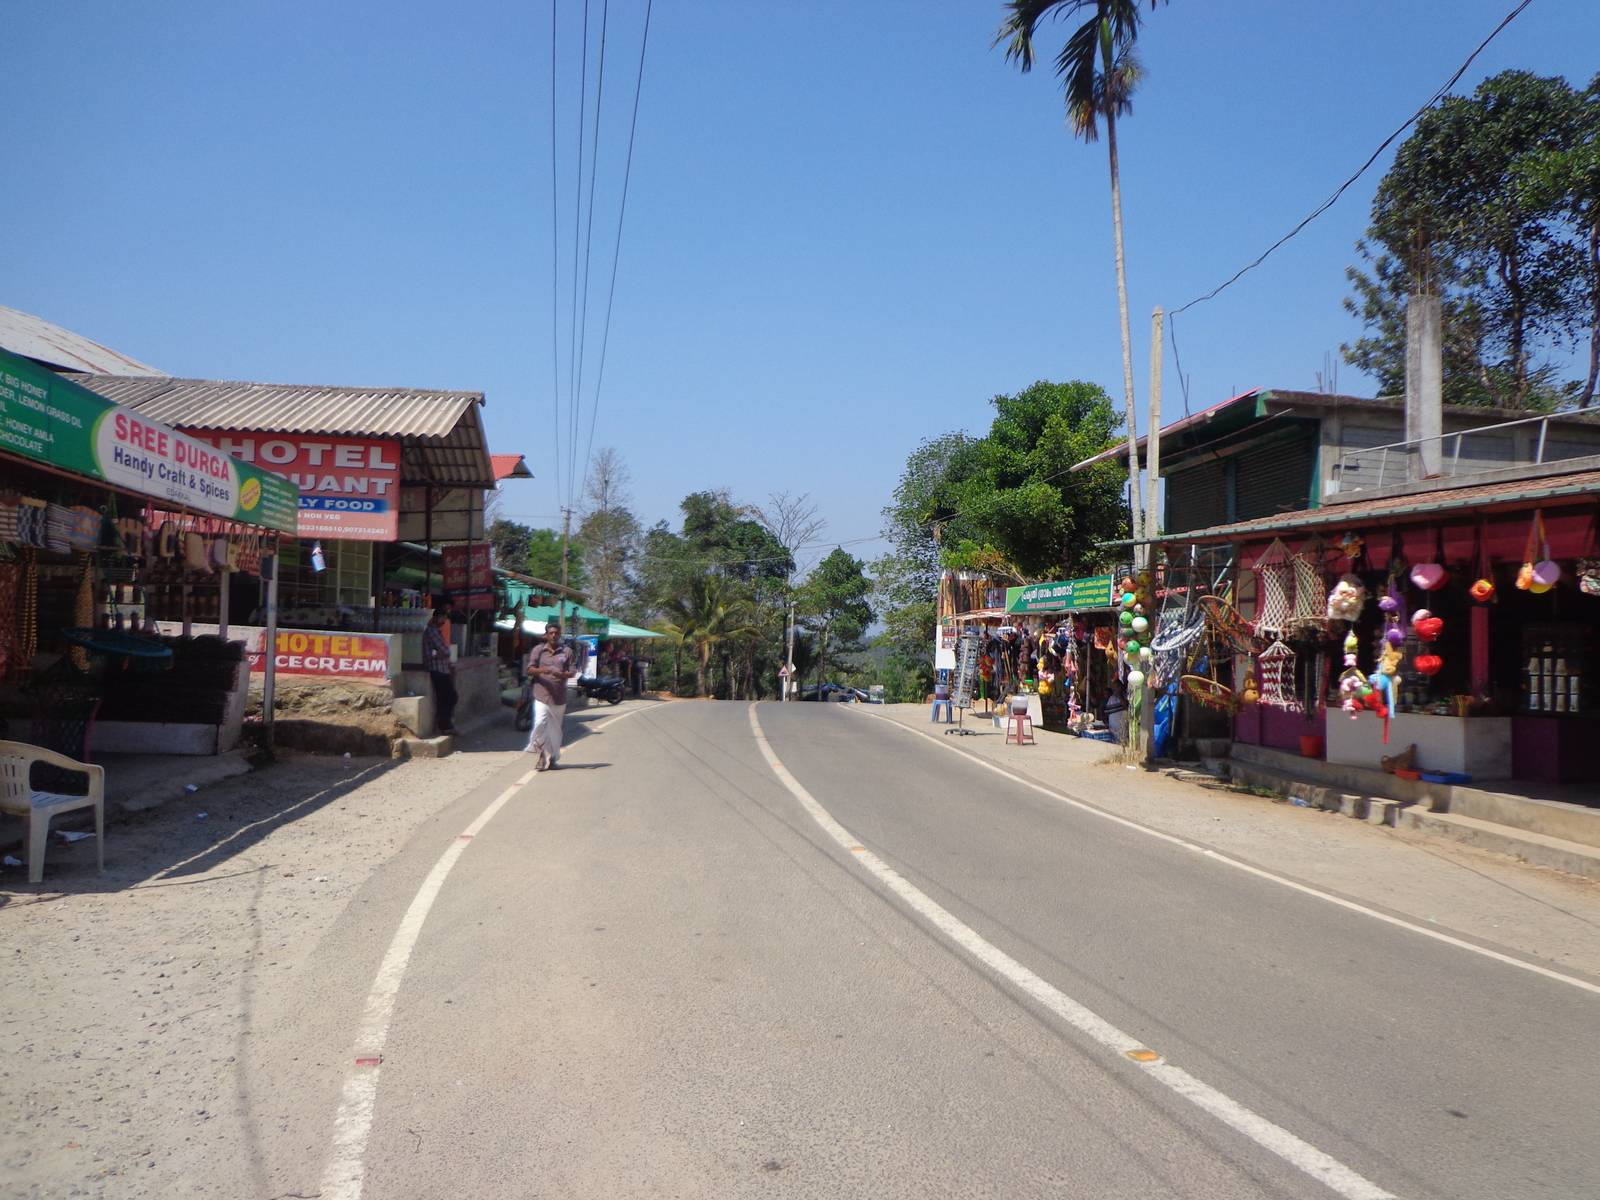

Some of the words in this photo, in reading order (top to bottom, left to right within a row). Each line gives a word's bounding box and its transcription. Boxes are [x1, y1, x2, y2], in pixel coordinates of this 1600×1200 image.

[5, 374, 19, 388] BIG
[20, 382, 48, 399] HONEY
[18, 394, 46, 412] LEMON
[46, 406, 71, 423] GRASS
[71, 416, 83, 428] OIL
[6, 417, 33, 435] HONEY
[115, 413, 169, 458] SREE
[175, 439, 230, 482] DURGA
[220, 438, 397, 470] HOTEL
[113, 446, 155, 479] Handy
[158, 463, 187, 486] Craft
[189, 474, 197, 489] &
[200, 478, 230, 501] Spices
[271, 472, 393, 495] UANT
[324, 499, 376, 511] FOOD
[265, 632, 374, 657] HOTEL
[275, 655, 387, 673] CECREAM
